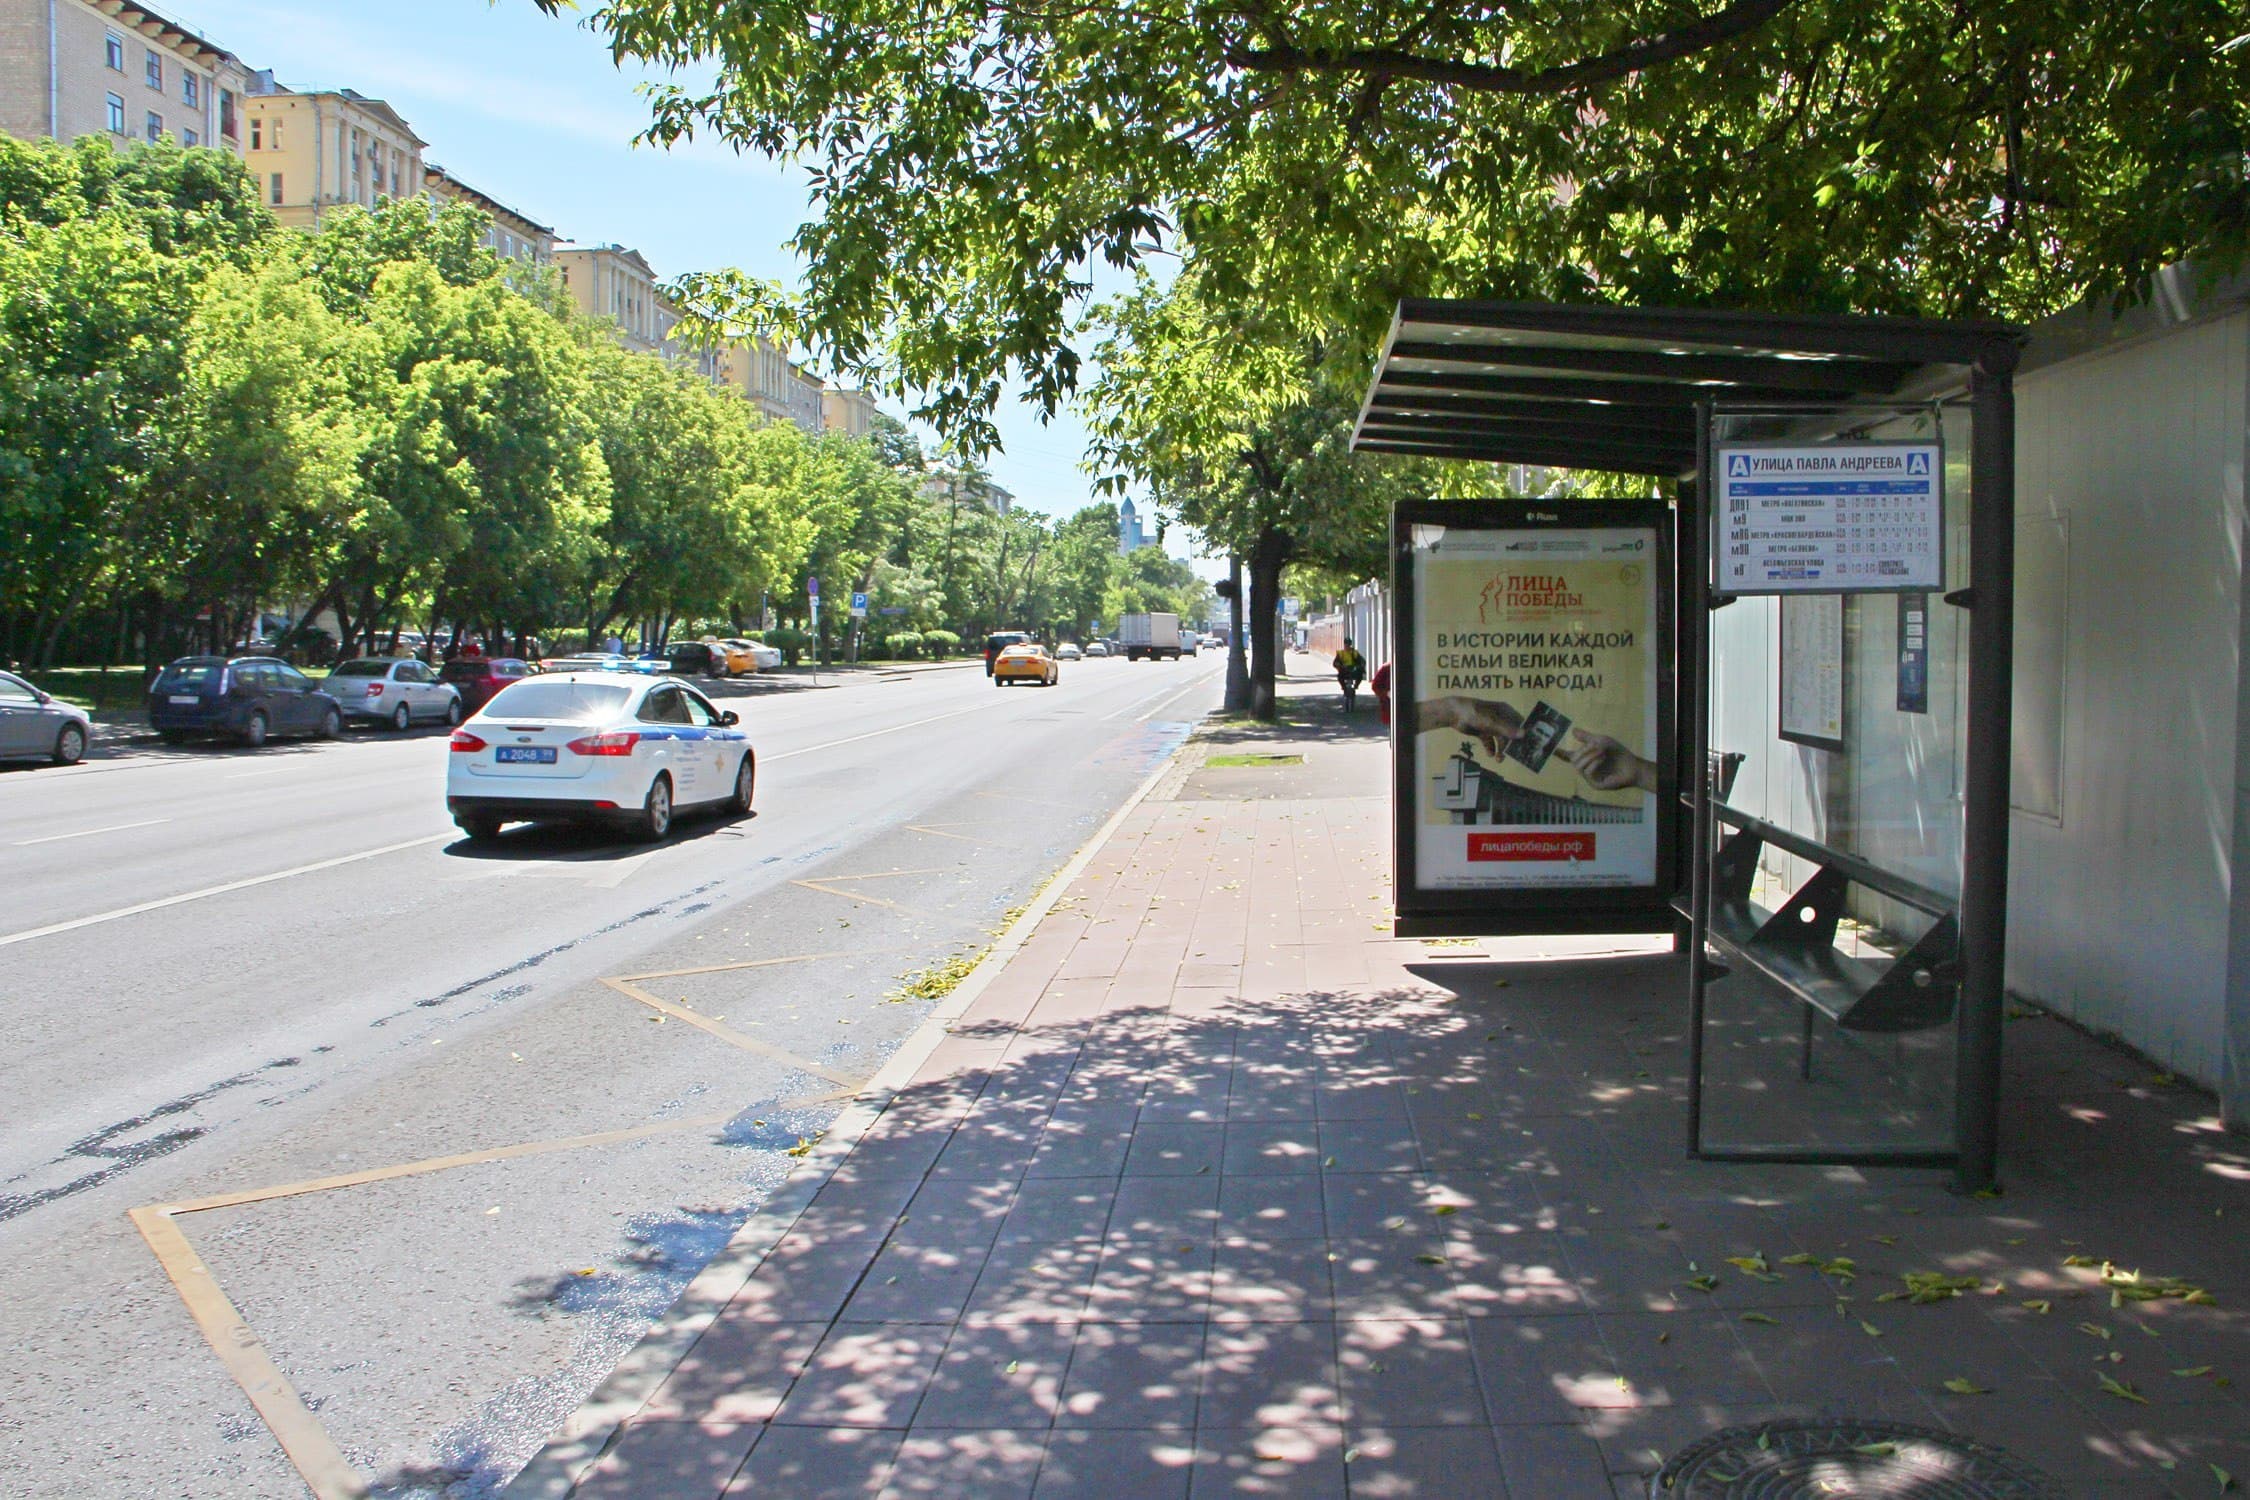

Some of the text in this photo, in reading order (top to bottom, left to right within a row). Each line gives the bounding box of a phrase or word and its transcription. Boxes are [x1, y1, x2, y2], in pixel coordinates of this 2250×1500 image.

[1753, 457, 1793, 473] УЛИЦА
[1796, 457, 1838, 471] ПАВЛА
[1840, 456, 1902, 472] АНДРЕЕВА
[1507, 575, 1568, 595] ЛИЦА
[1506, 593, 1583, 609] ПОБЕДЫ
[1437, 630, 1634, 650] В ИСТОРИИ КАЖДОЙ
[1437, 654, 1593, 669] СЕМЬИ ВЕЛИКАЯ
[1437, 674, 1602, 691] ПАМЯТЬ НАРОДА!
[511, 748, 537, 761] 2048
[1480, 841, 1583, 854] лицапобеды.рф
